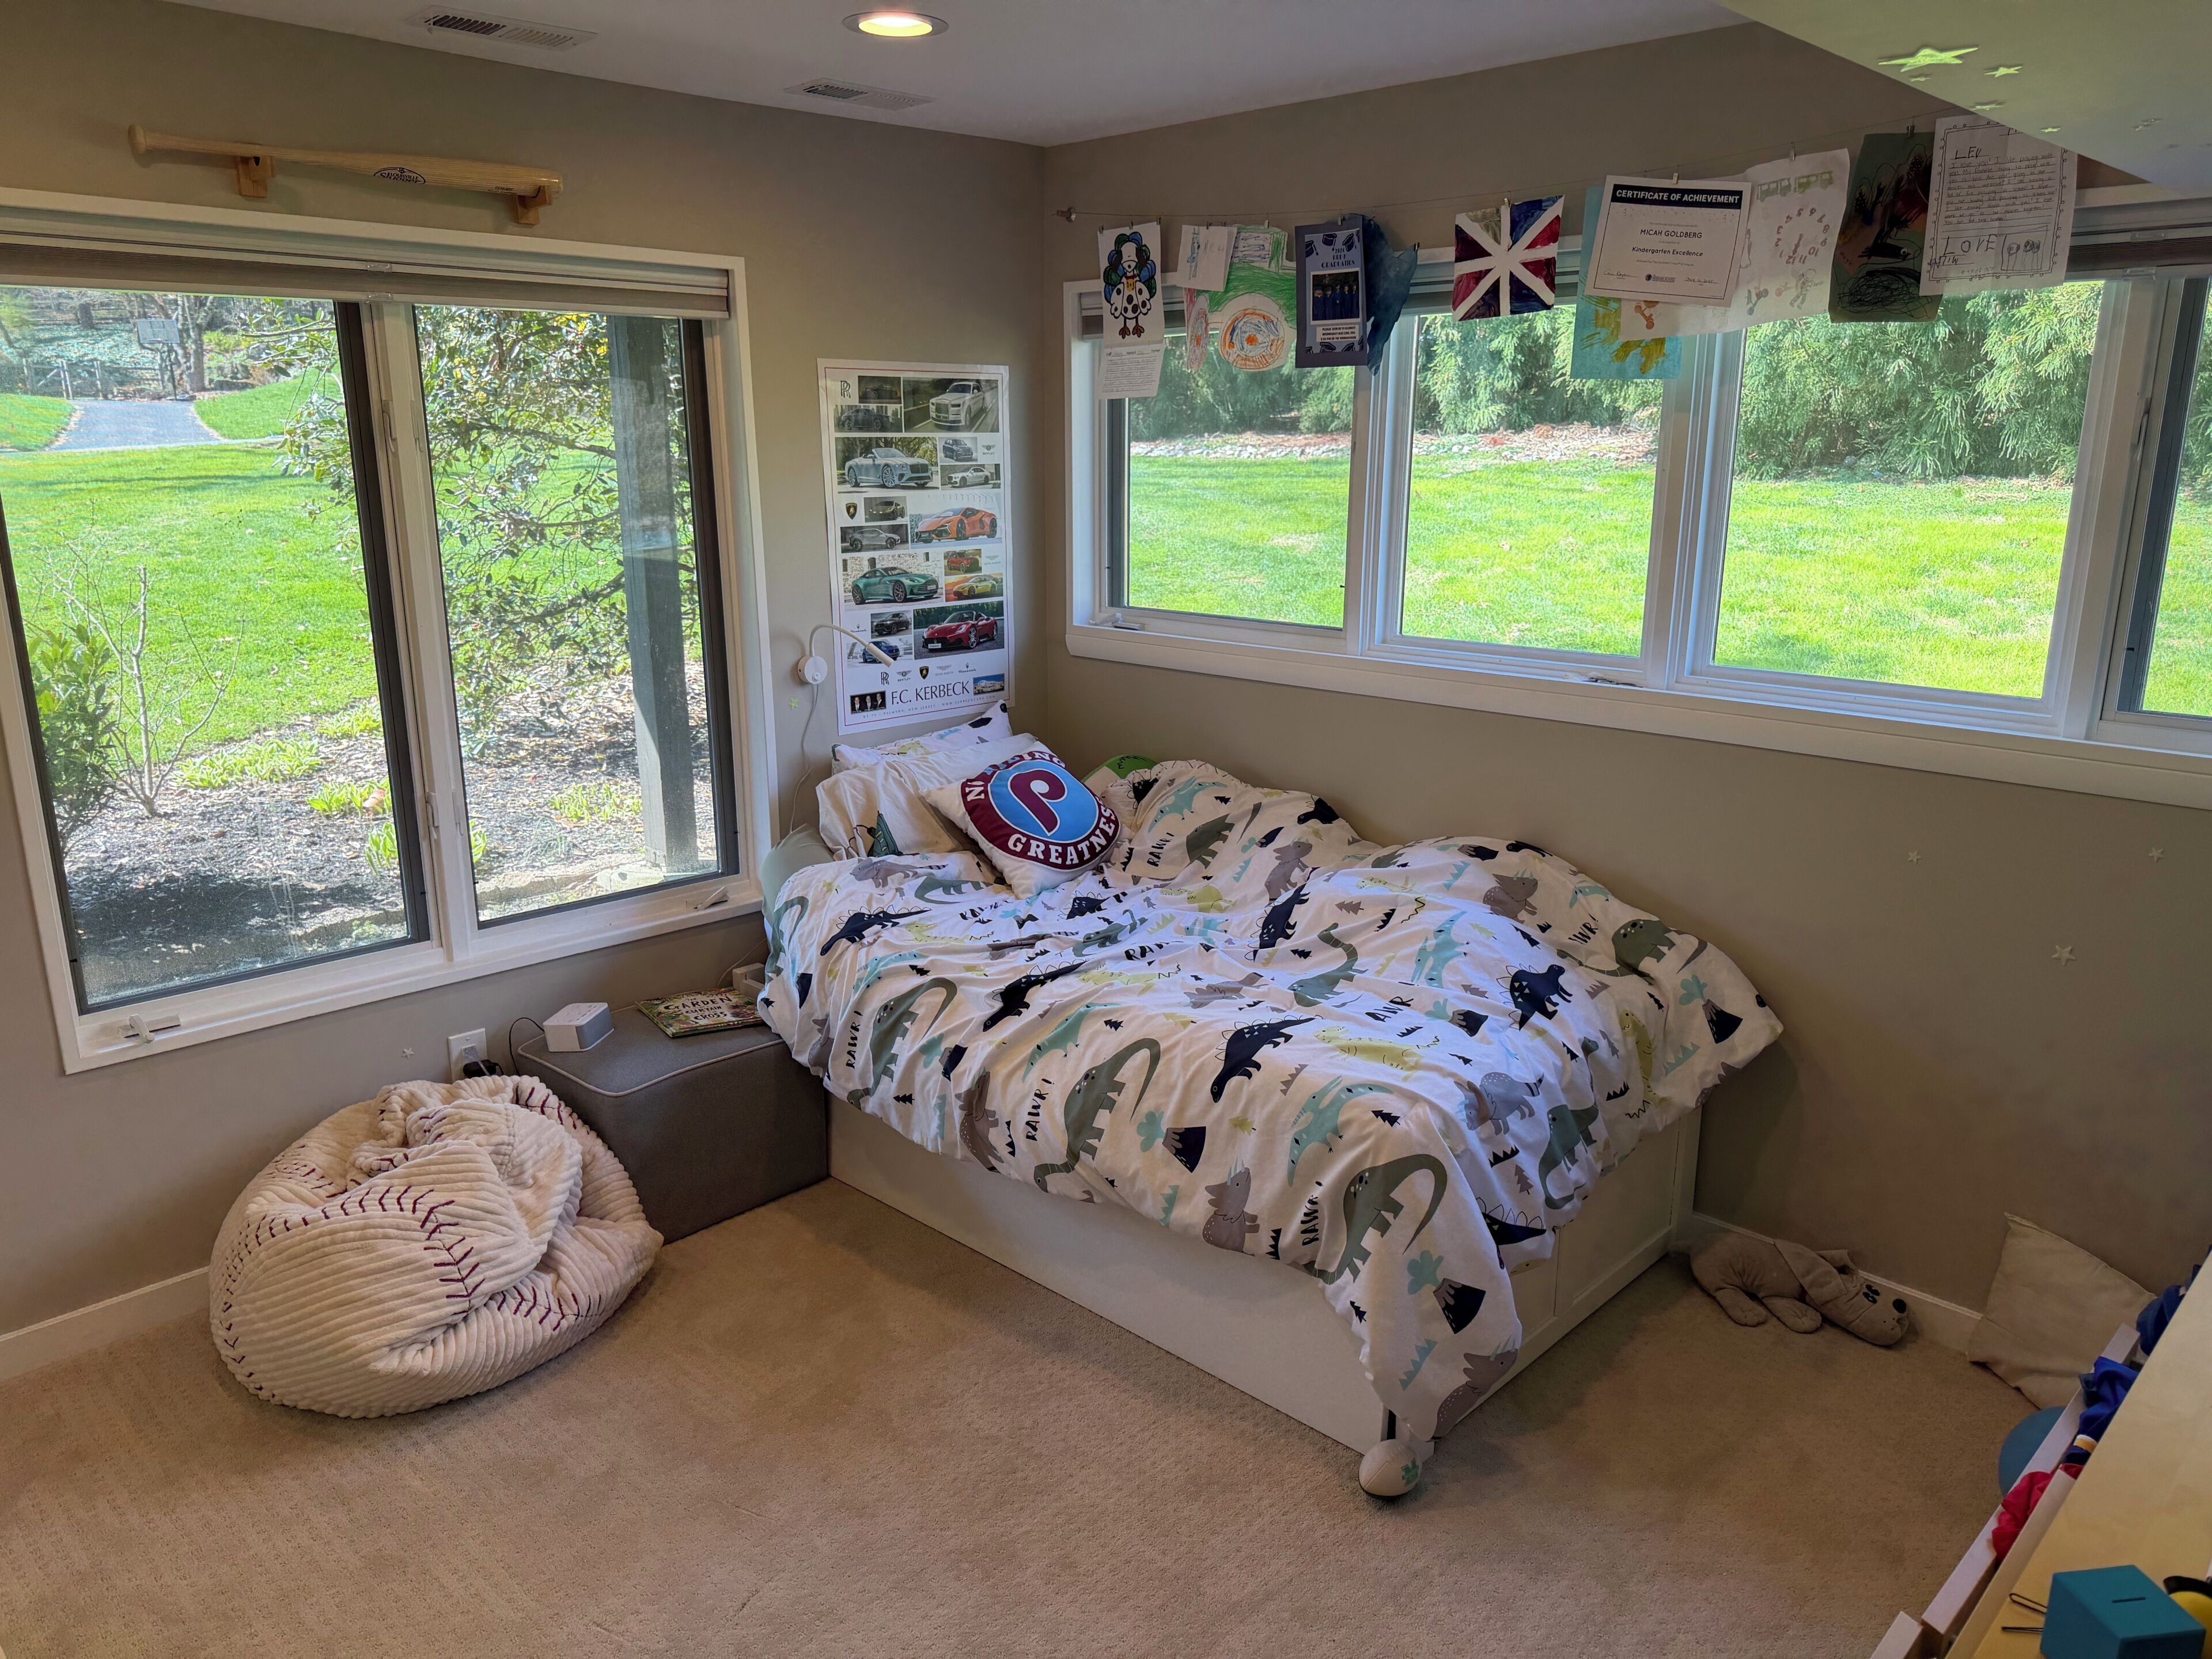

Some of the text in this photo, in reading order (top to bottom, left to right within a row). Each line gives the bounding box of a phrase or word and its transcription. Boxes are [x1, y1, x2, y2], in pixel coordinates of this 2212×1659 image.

[1955, 146, 1982, 159] LEV
[390, 172, 418, 180] LOUISVILLE
[1616, 190, 1740, 204] CERTIFICATE OF ACHIEVEMENT
[1664, 230, 1703, 238] GOLDBERG
[1777, 225, 1783, 234] 3
[1823, 224, 1830, 234] 8
[1775, 238, 1782, 248] 2
[1944, 234, 1998, 255] LOVE
[1631, 247, 1671, 255] Kindergarten
[1808, 247, 1819, 257] 10
[1321, 260, 1355, 268] GRADUATION
[1785, 255, 1797, 266] 12
[1798, 254, 1808, 265] 11
[891, 680, 970, 705] F.C. KERBECK
[664, 996, 732, 1012] GARDEN
[1365, 996, 1414, 1022] AWR
[685, 1005, 722, 1014] CURTAIN
[694, 1011, 728, 1020] CROSS
